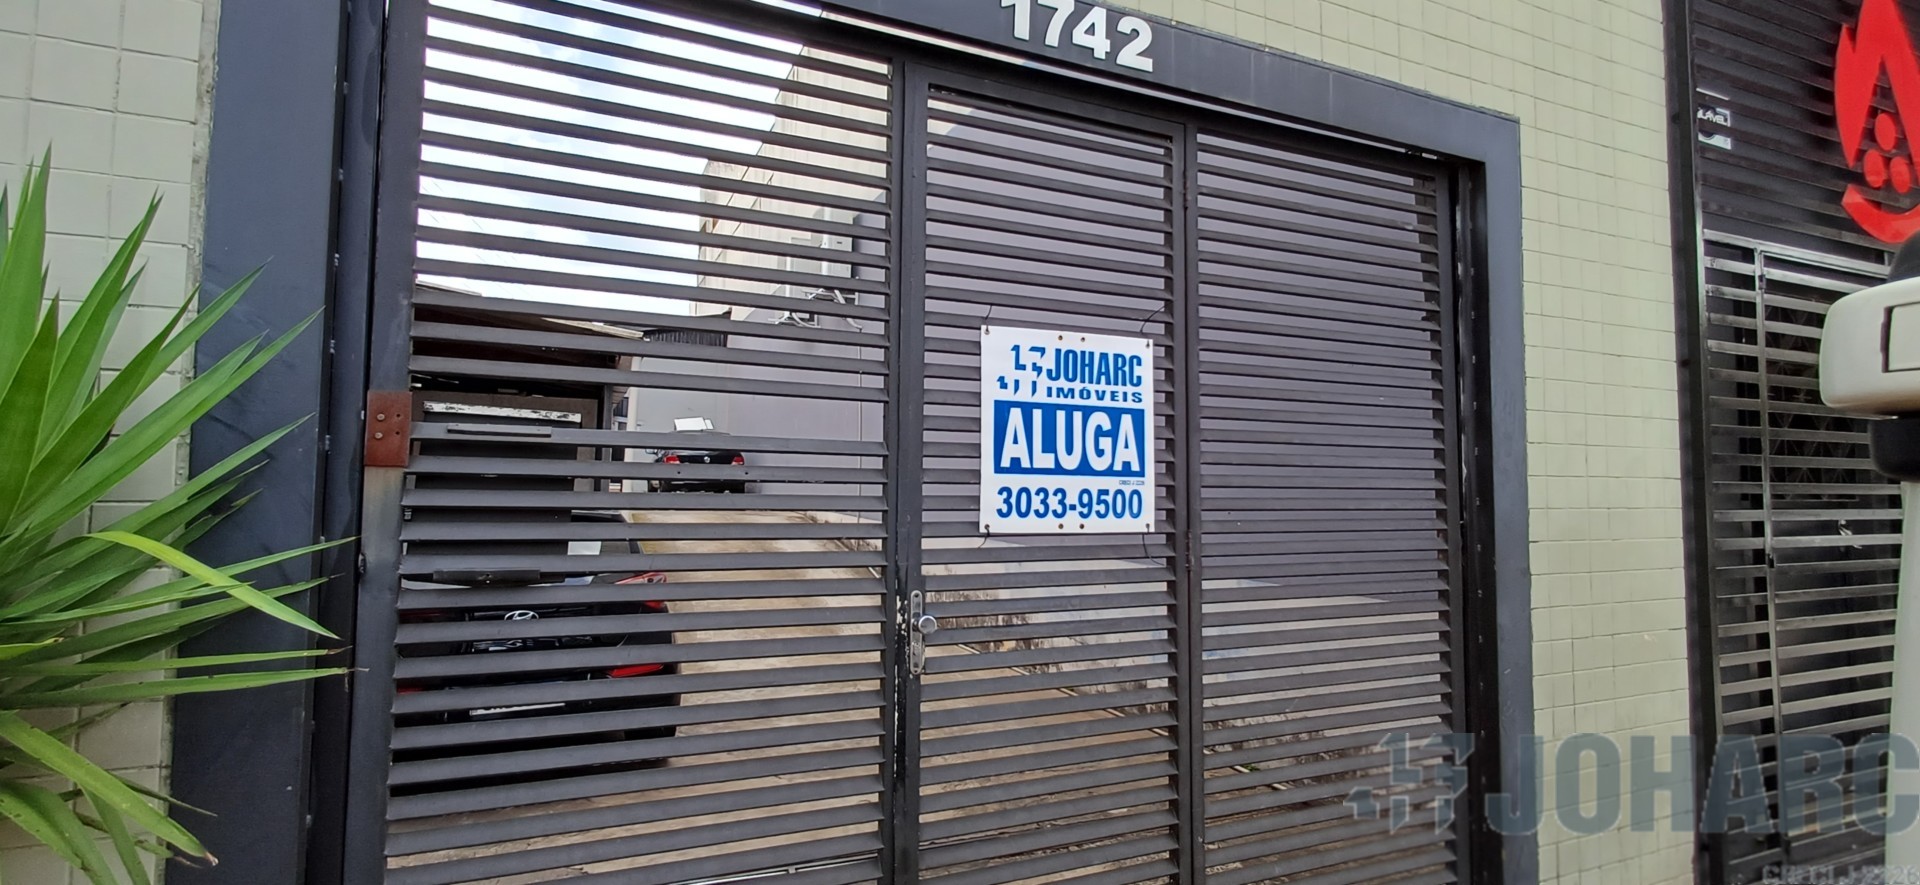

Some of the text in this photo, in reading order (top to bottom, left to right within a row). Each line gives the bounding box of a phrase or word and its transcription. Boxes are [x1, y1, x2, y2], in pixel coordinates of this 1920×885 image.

[1001, 0, 1153, 72] 1742
[1046, 348, 1142, 387] JOHARC
[1046, 386, 1143, 403] IMÓVEIS
[1000, 407, 1141, 472] ALUGA
[996, 486, 1143, 519] 3033-9500
